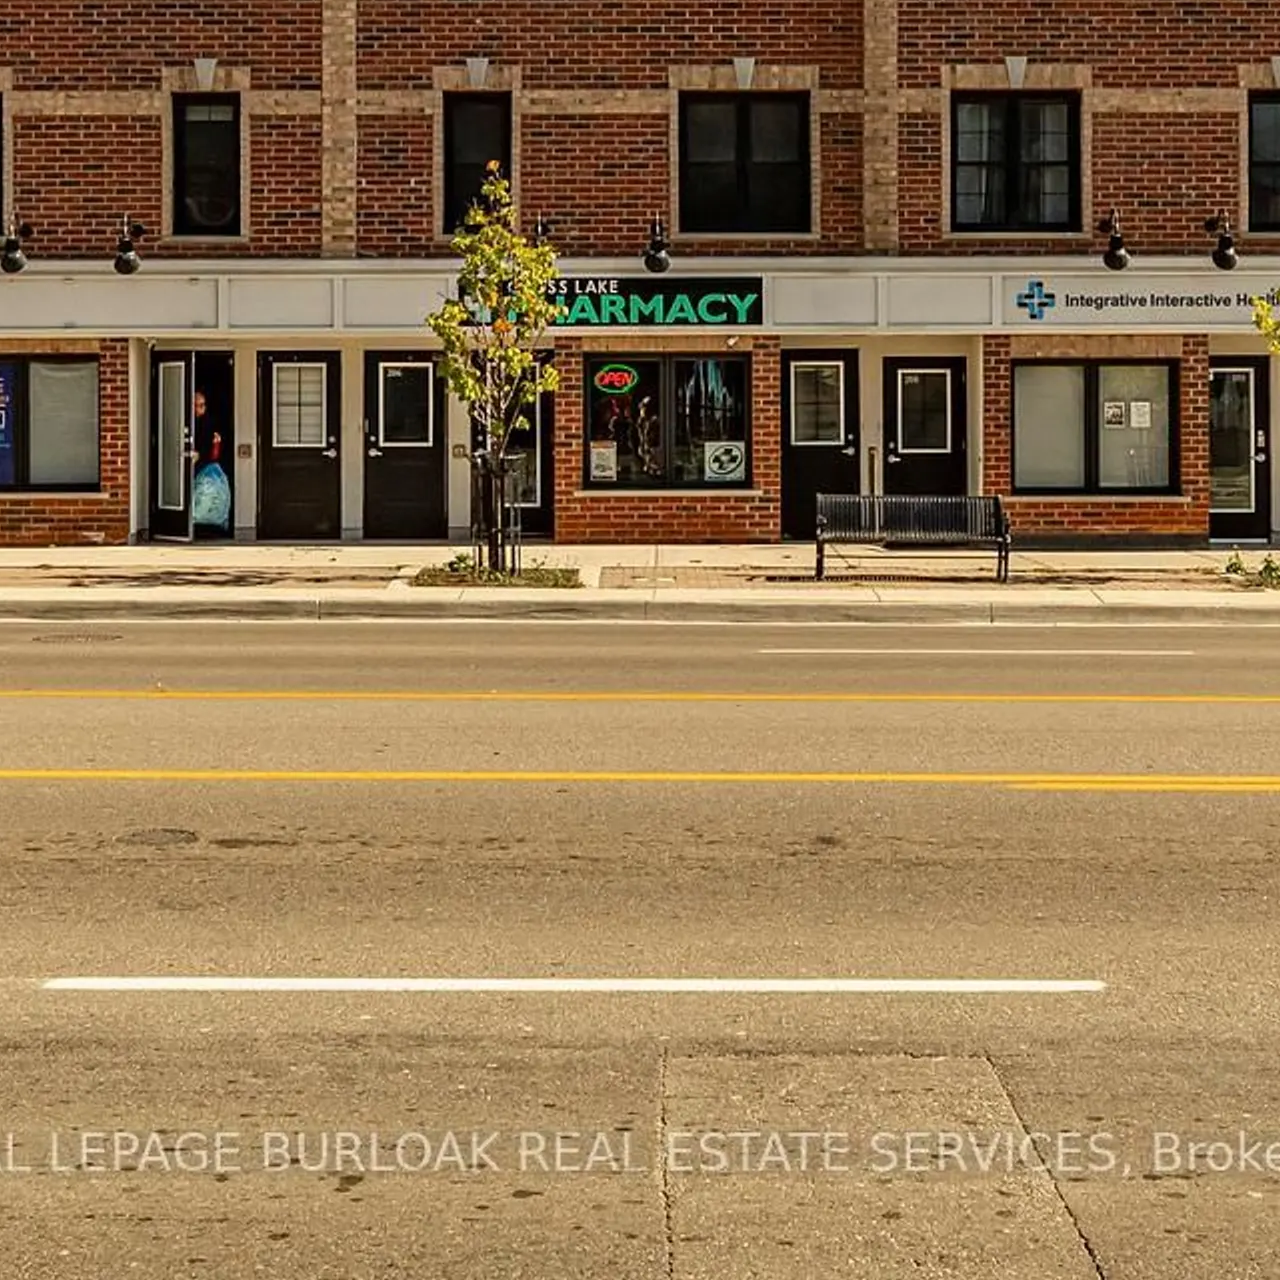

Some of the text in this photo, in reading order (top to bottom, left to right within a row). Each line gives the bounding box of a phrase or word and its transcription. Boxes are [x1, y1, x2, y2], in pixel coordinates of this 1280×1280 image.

[575, 279, 619, 293] LAKE
[508, 293, 759, 324] ARMACY
[1065, 293, 1148, 310] Integrative
[1150, 293, 1231, 307] Interactive
[599, 371, 633, 387] OPEN
